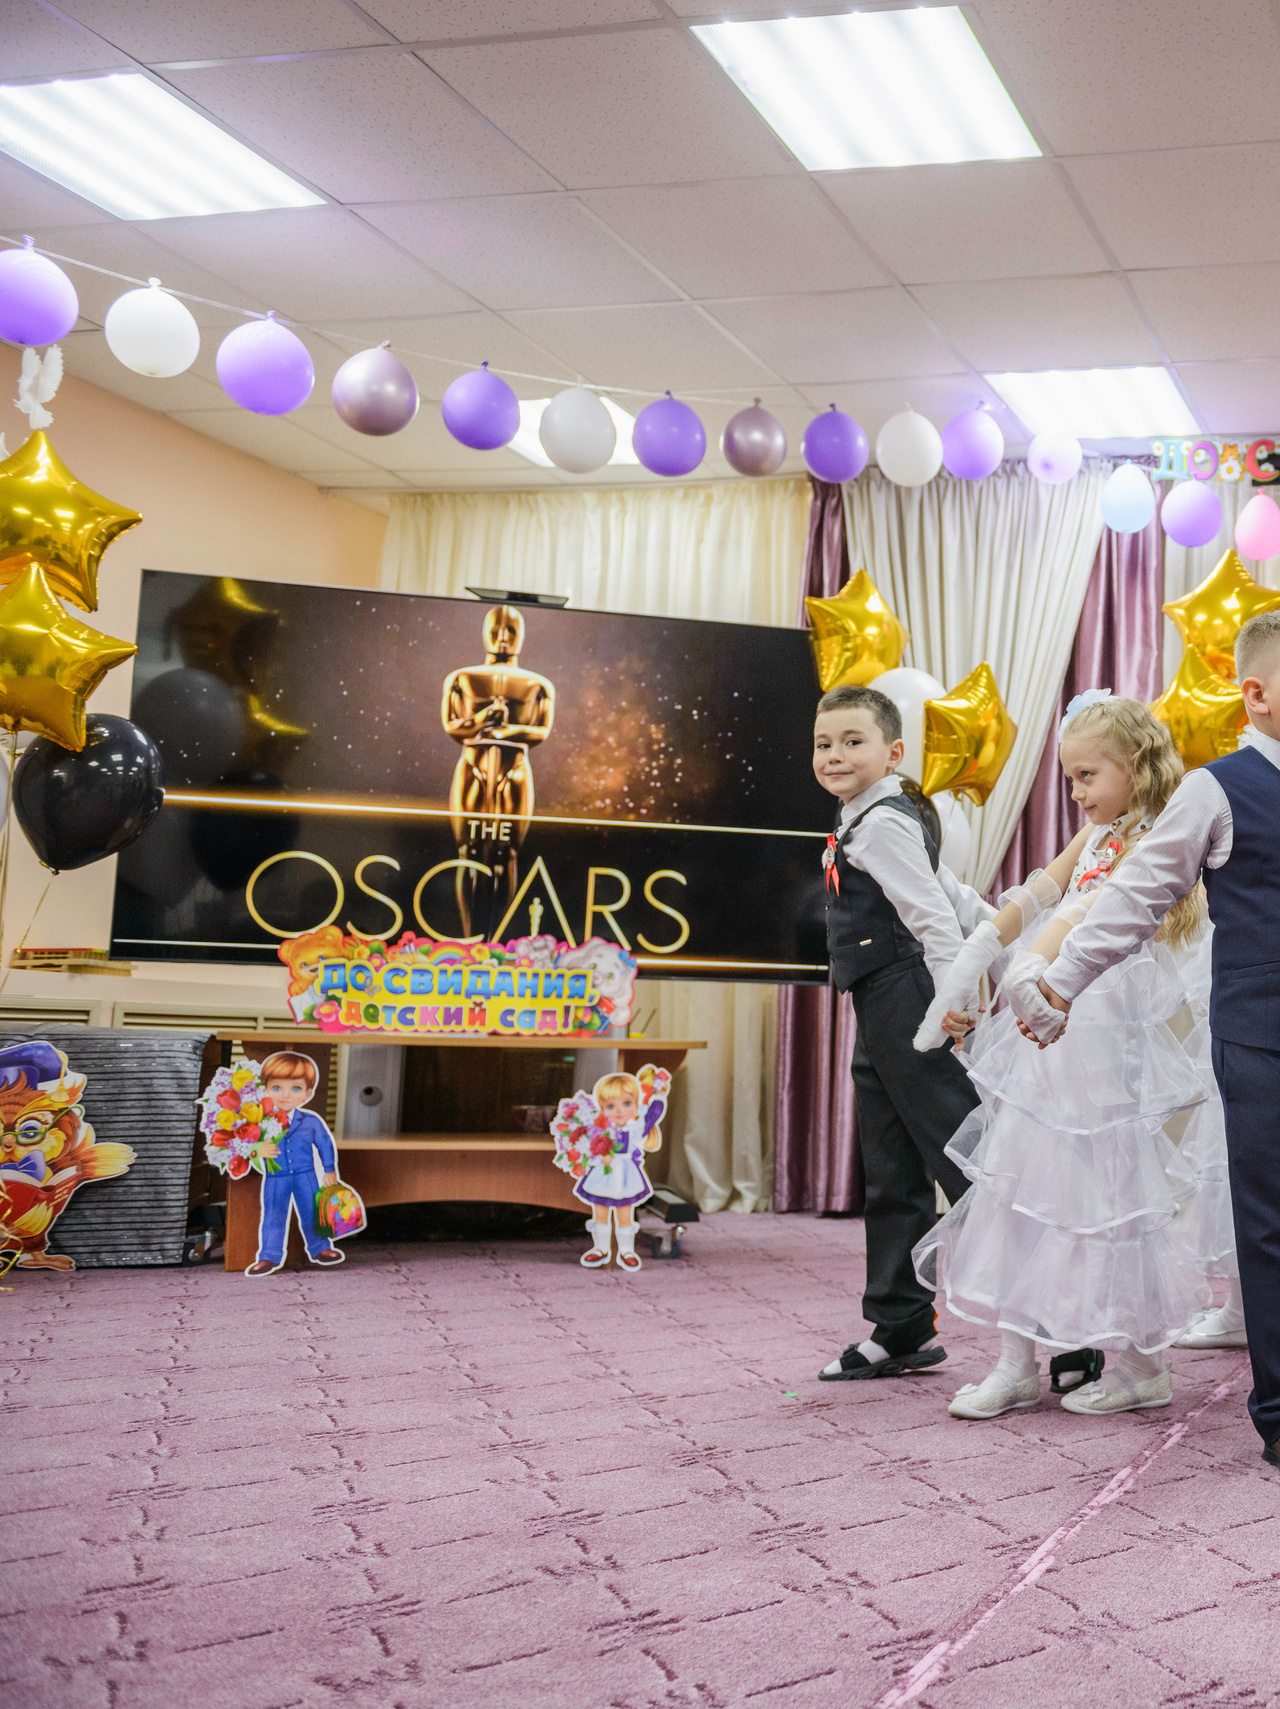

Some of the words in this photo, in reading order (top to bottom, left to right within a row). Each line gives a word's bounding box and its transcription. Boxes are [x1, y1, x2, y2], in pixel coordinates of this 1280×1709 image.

[1153, 438, 1219, 482] ДО
[467, 820, 512, 841] THE
[246, 850, 690, 954] OSCARS
[319, 962, 373, 995] ДО
[382, 967, 598, 1003] СВИДАНИЯ,
